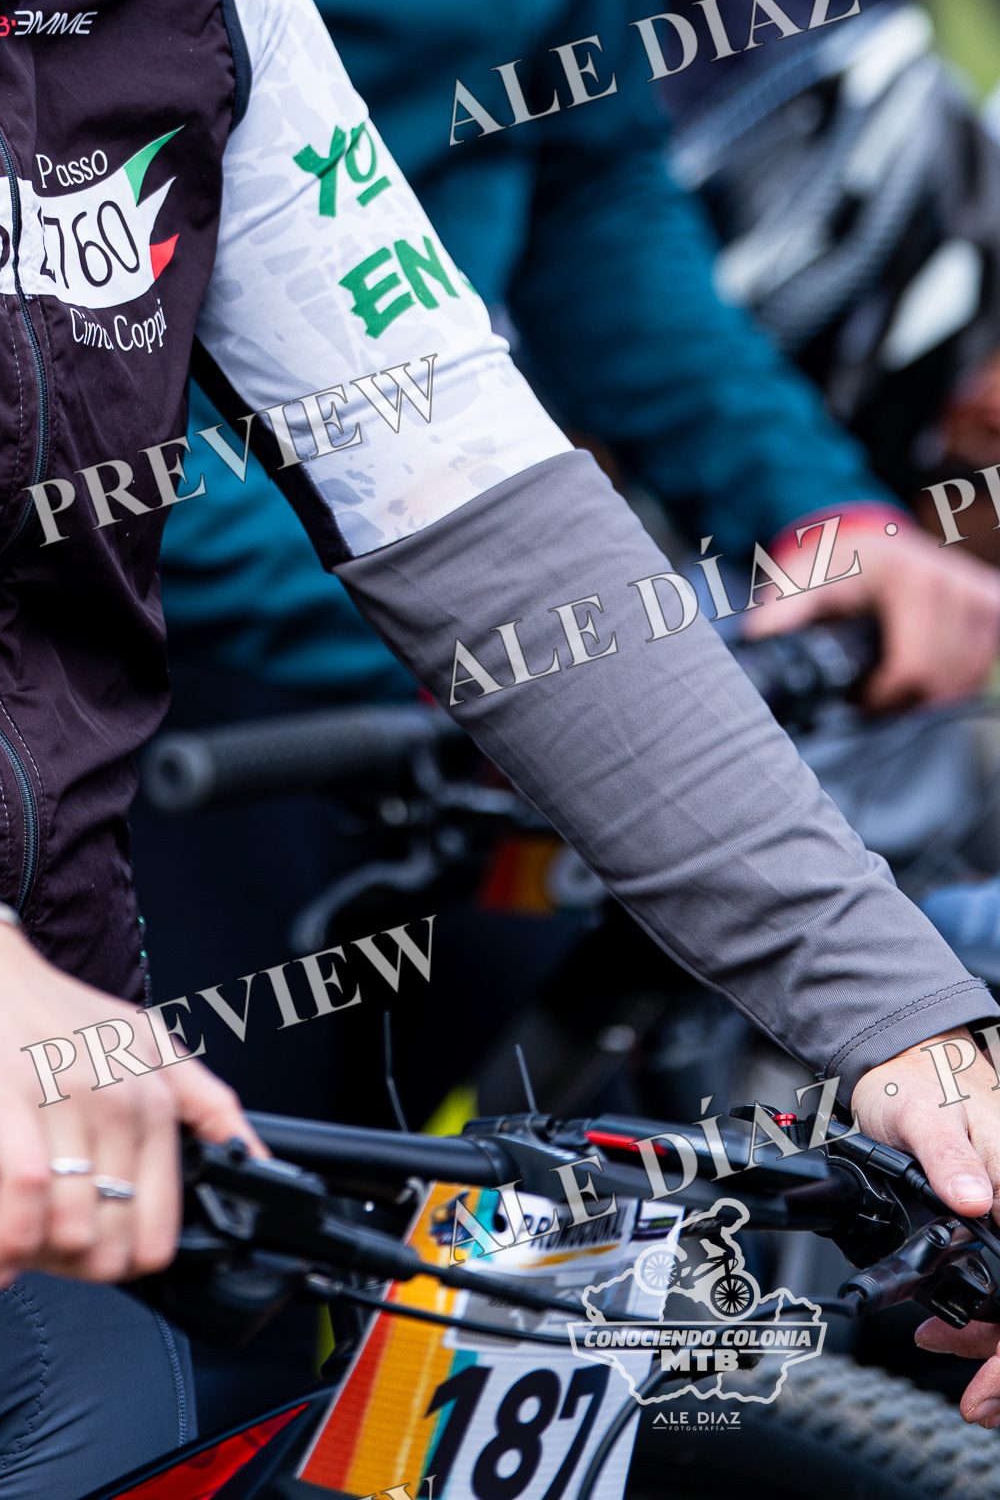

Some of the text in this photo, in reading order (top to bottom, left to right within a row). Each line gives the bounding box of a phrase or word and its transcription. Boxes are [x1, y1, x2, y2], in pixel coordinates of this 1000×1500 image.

[36, 149, 109, 188] Passo
[292, 121, 392, 218] YO
[113, 298, 168, 354] Coppi
[338, 235, 460, 340] EN
[416, 1364, 612, 1500] 187
